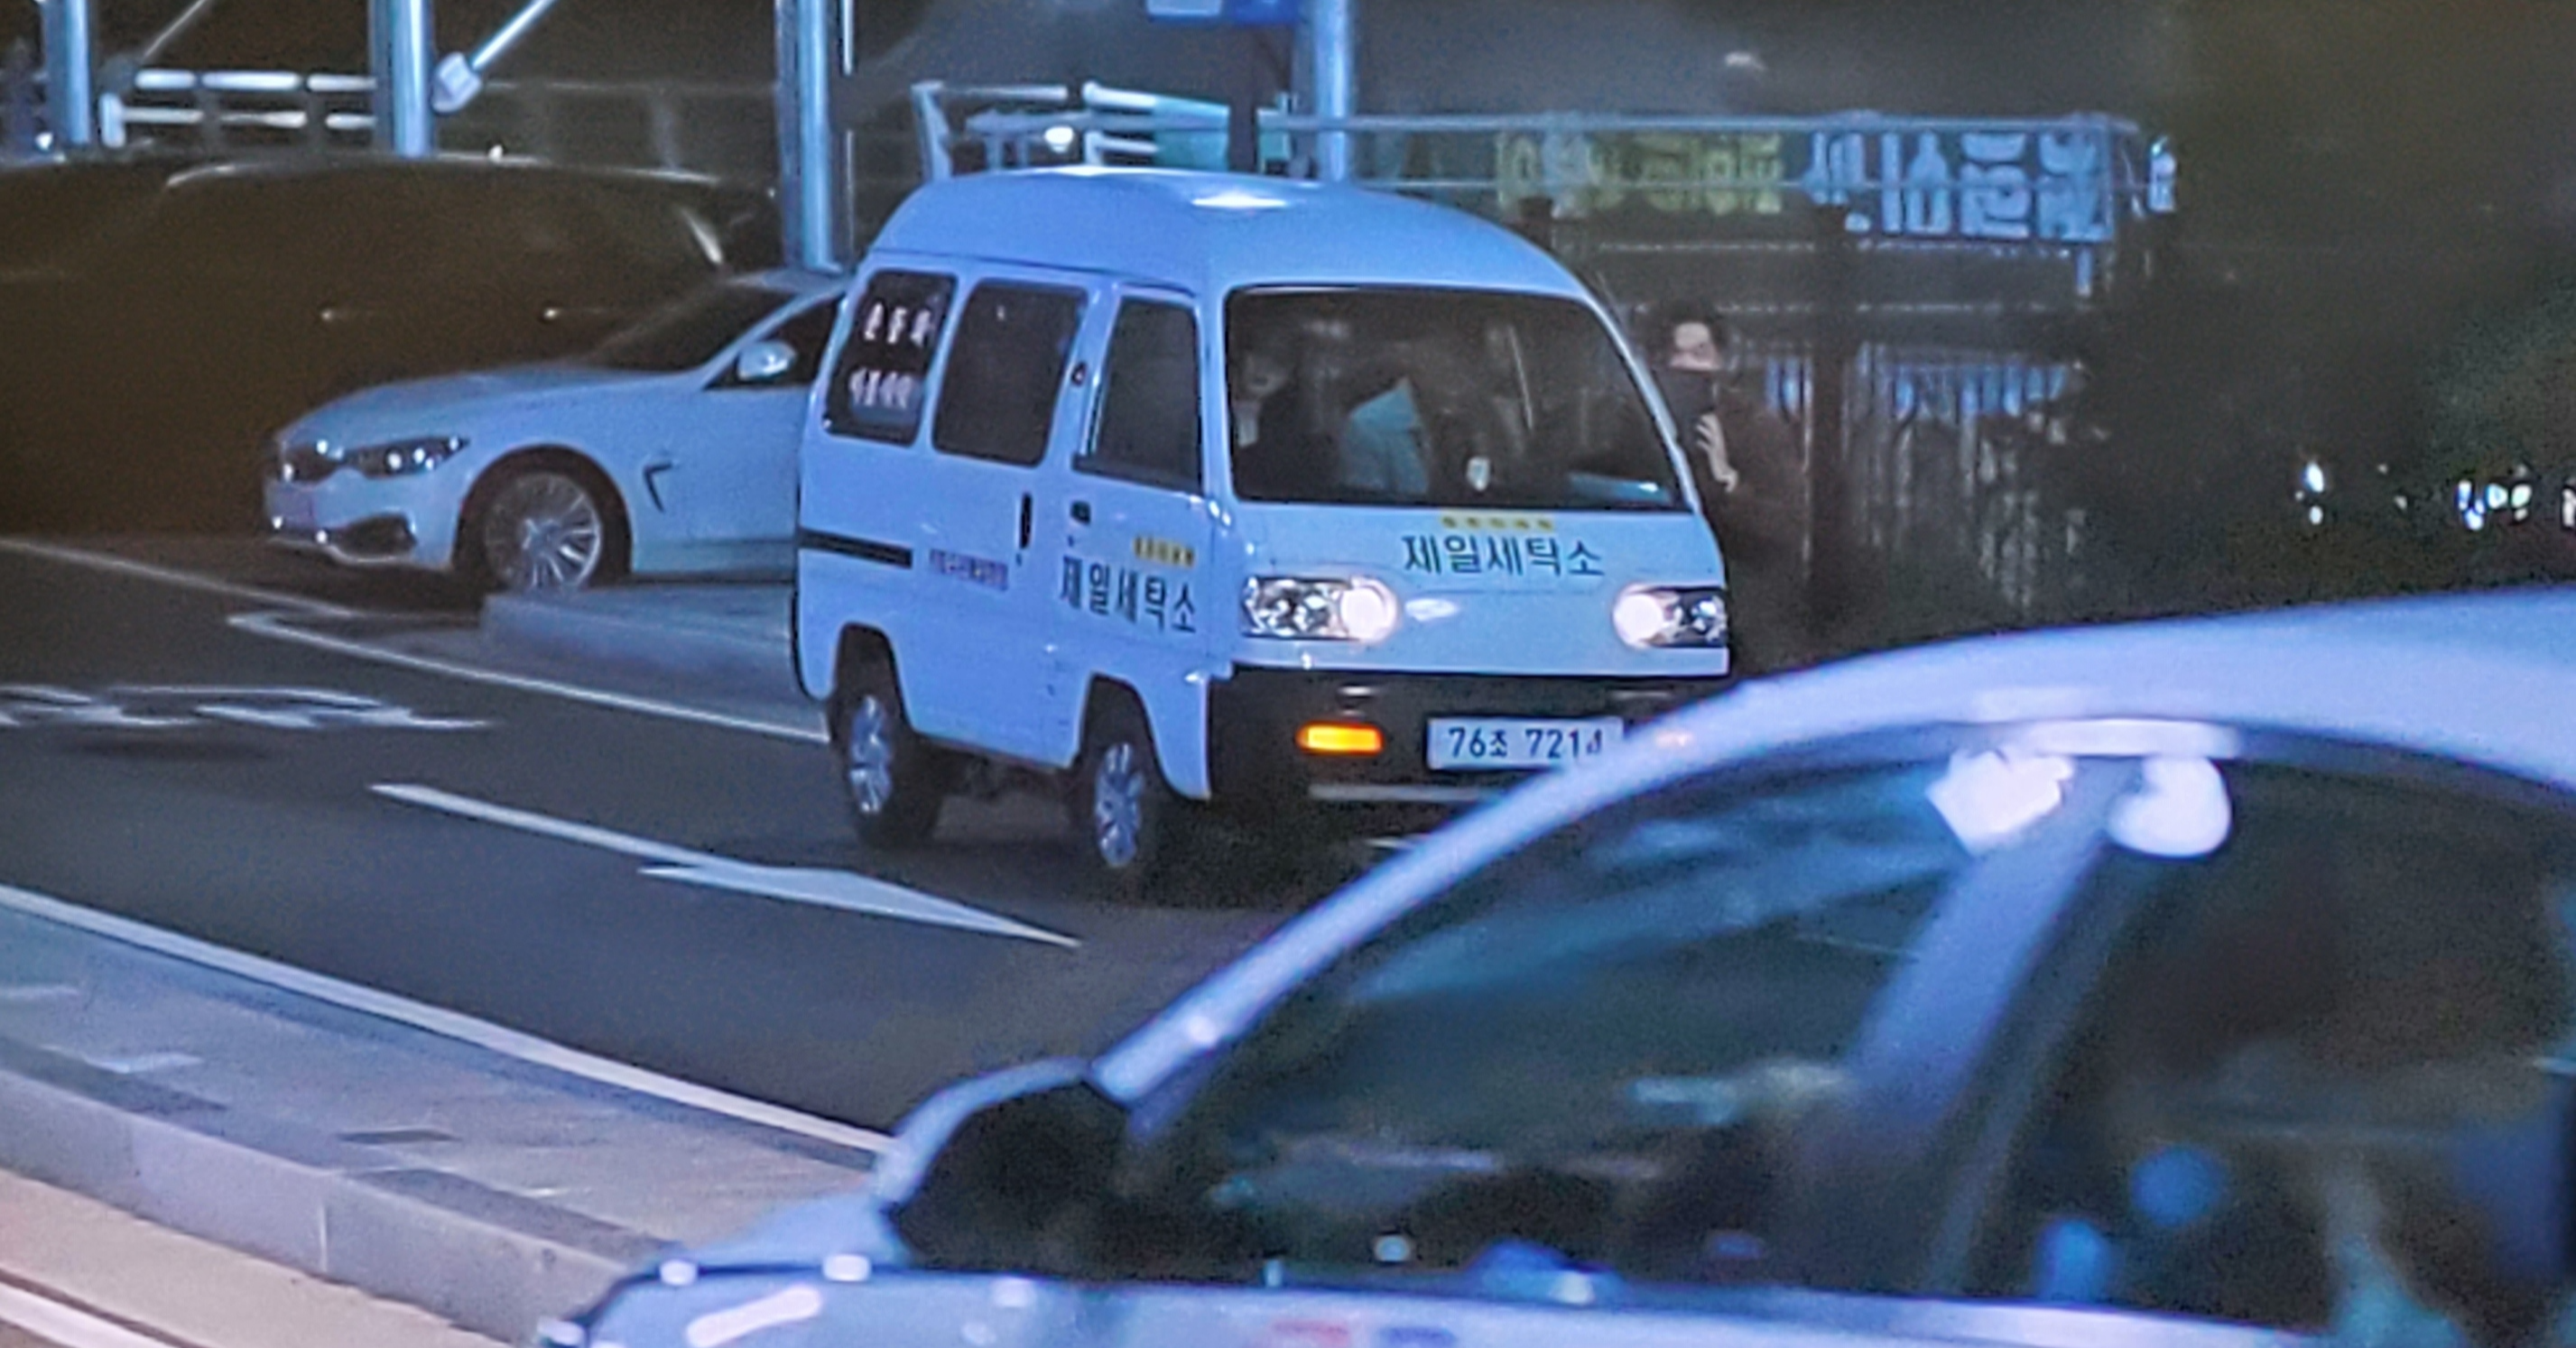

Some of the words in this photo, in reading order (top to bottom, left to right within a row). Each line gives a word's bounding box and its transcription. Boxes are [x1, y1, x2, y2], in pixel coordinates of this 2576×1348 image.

[1401, 534, 1605, 577] 제일세탁소
[1060, 554, 1197, 633] 제일세탁소
[1449, 727, 1507, 759] 76조
